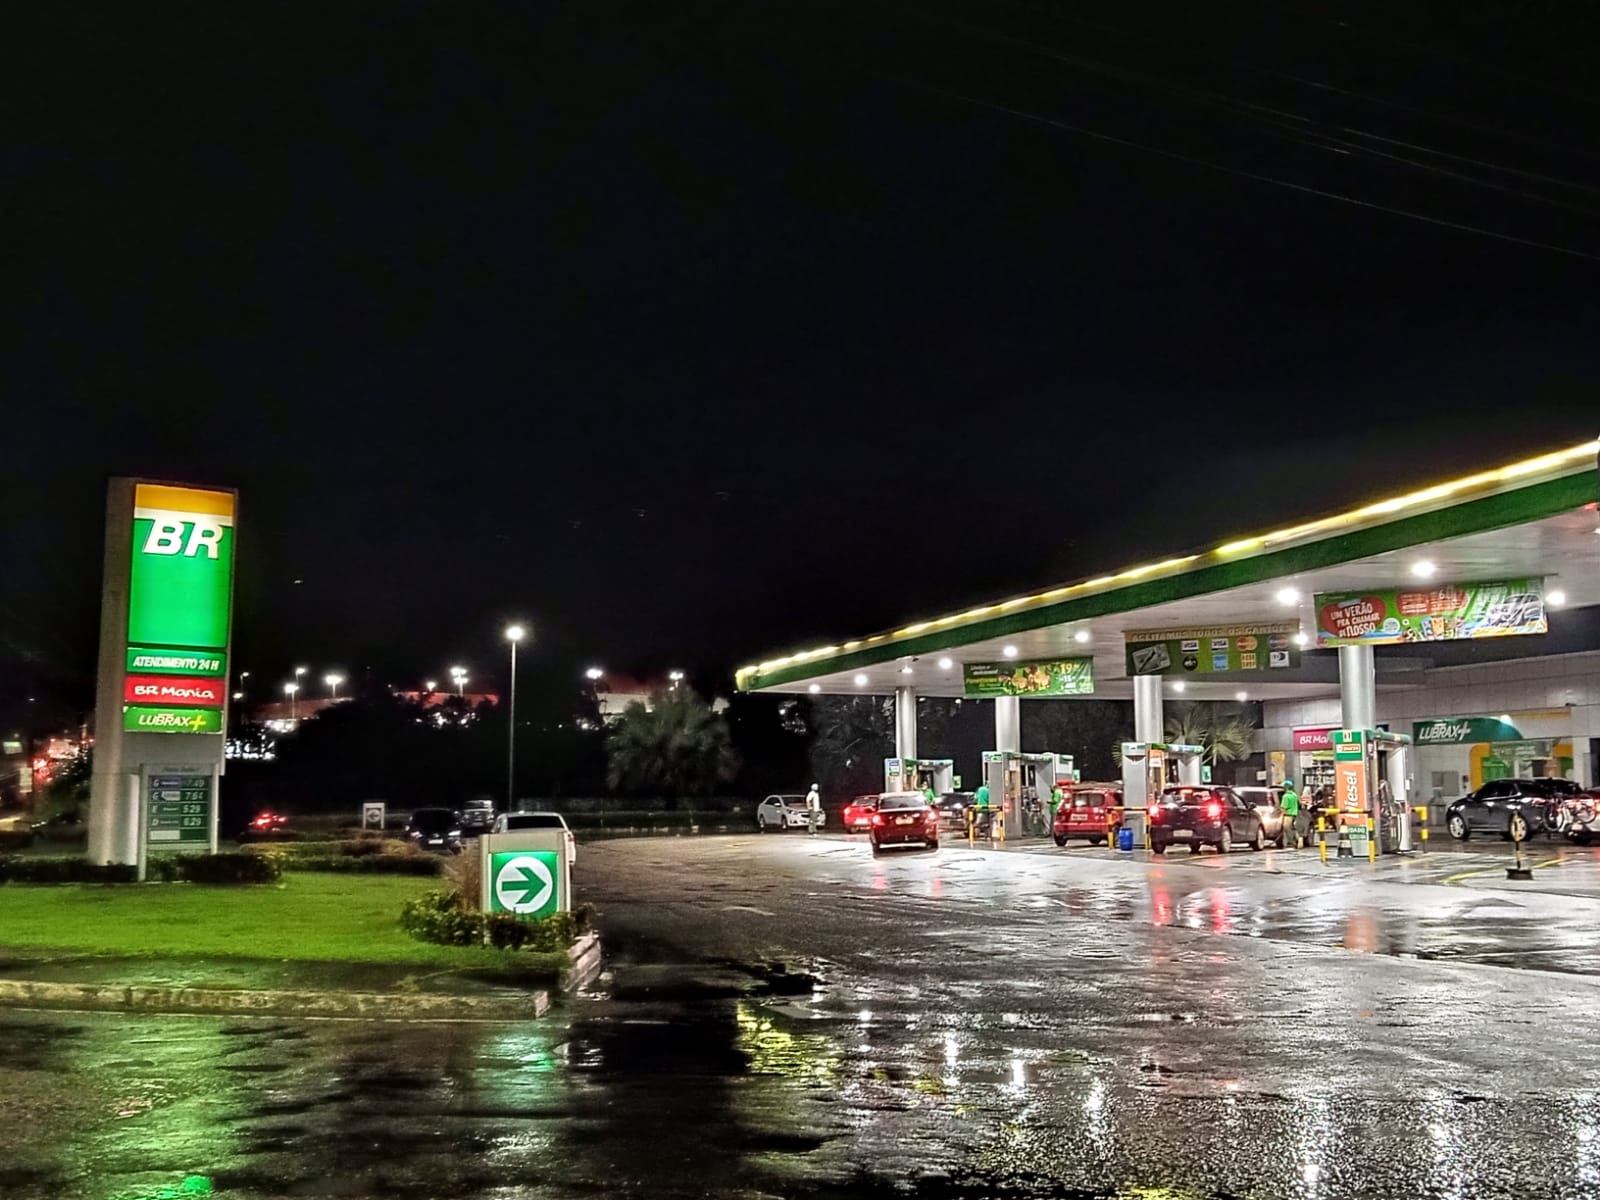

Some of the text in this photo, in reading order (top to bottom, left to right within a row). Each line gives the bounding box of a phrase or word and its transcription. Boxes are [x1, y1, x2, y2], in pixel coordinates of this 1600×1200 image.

[142, 515, 223, 559] BR
[1344, 602, 1373, 618] VERÃO
[133, 656, 220, 671] ATENDIMENTO 24 H
[134, 685, 215, 699] BR Mania
[1299, 735, 1313, 745] BR
